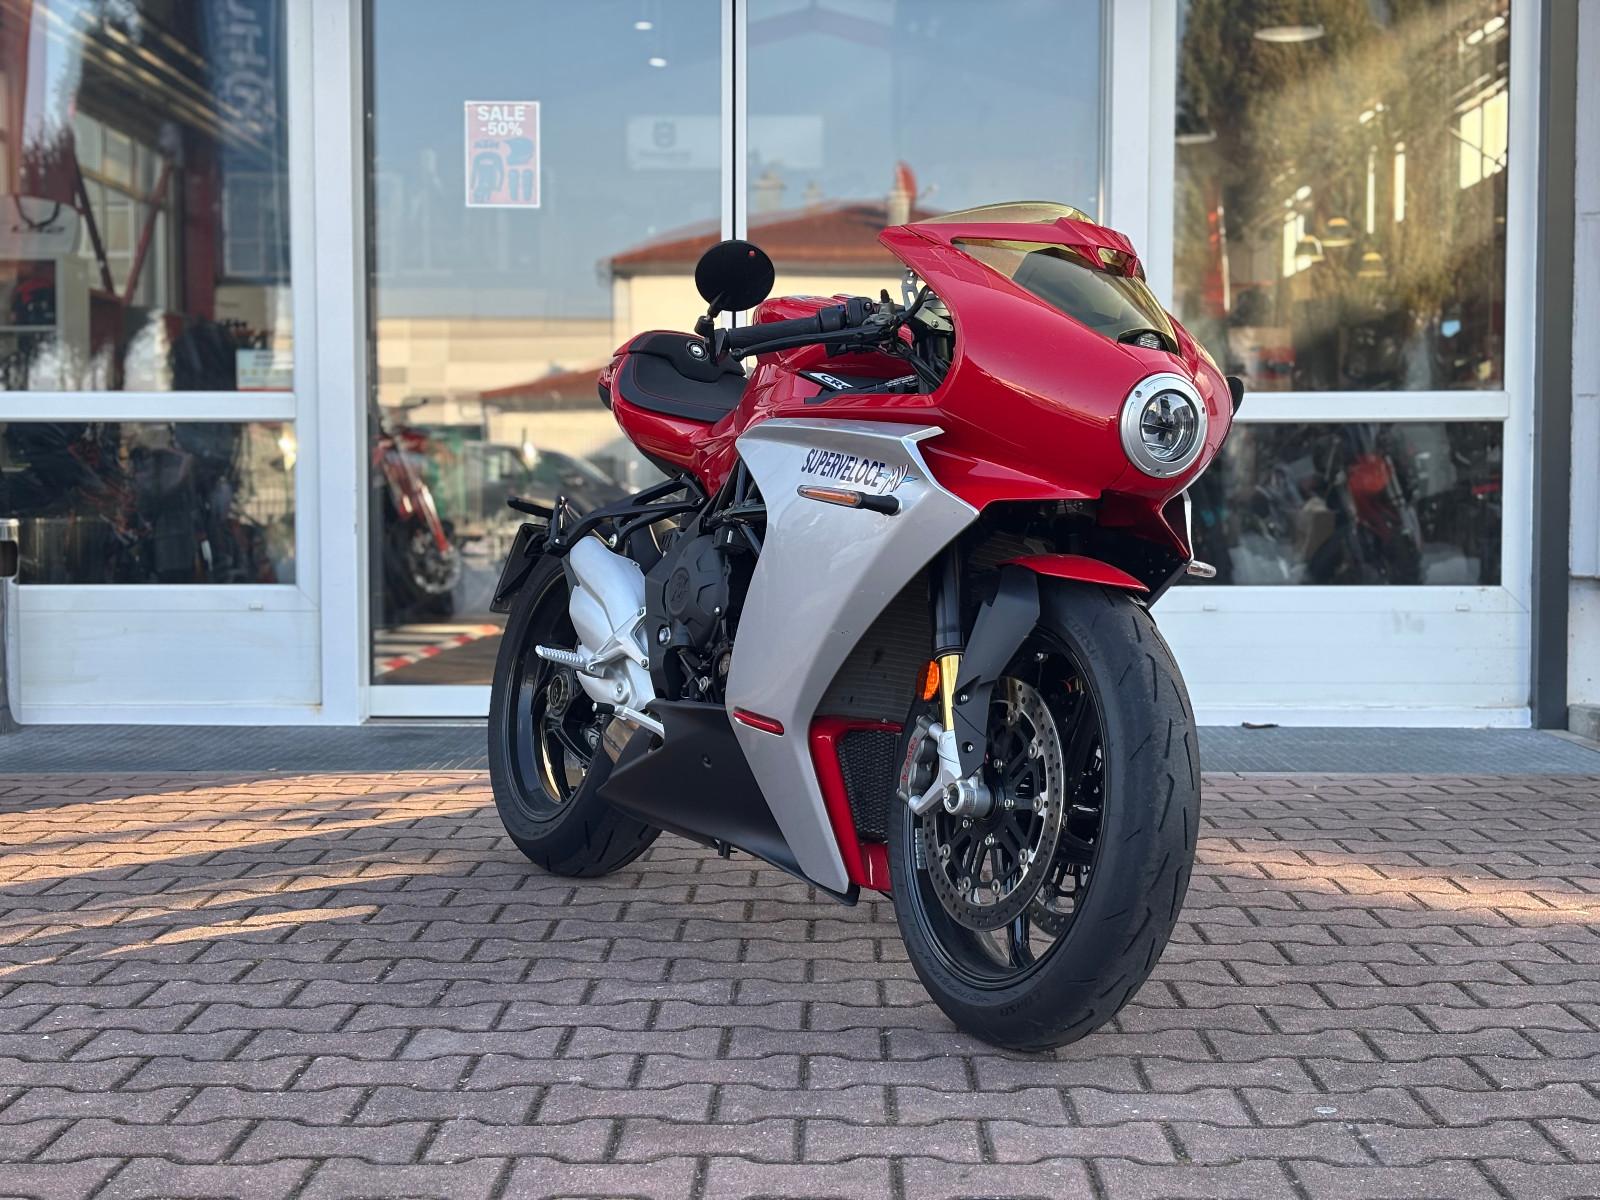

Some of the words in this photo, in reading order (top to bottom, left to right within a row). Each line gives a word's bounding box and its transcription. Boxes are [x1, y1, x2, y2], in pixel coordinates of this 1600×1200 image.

[477, 105, 526, 121] SALE
[480, 121, 523, 136] -50%
[801, 448, 886, 488] SUPERVELOCE
